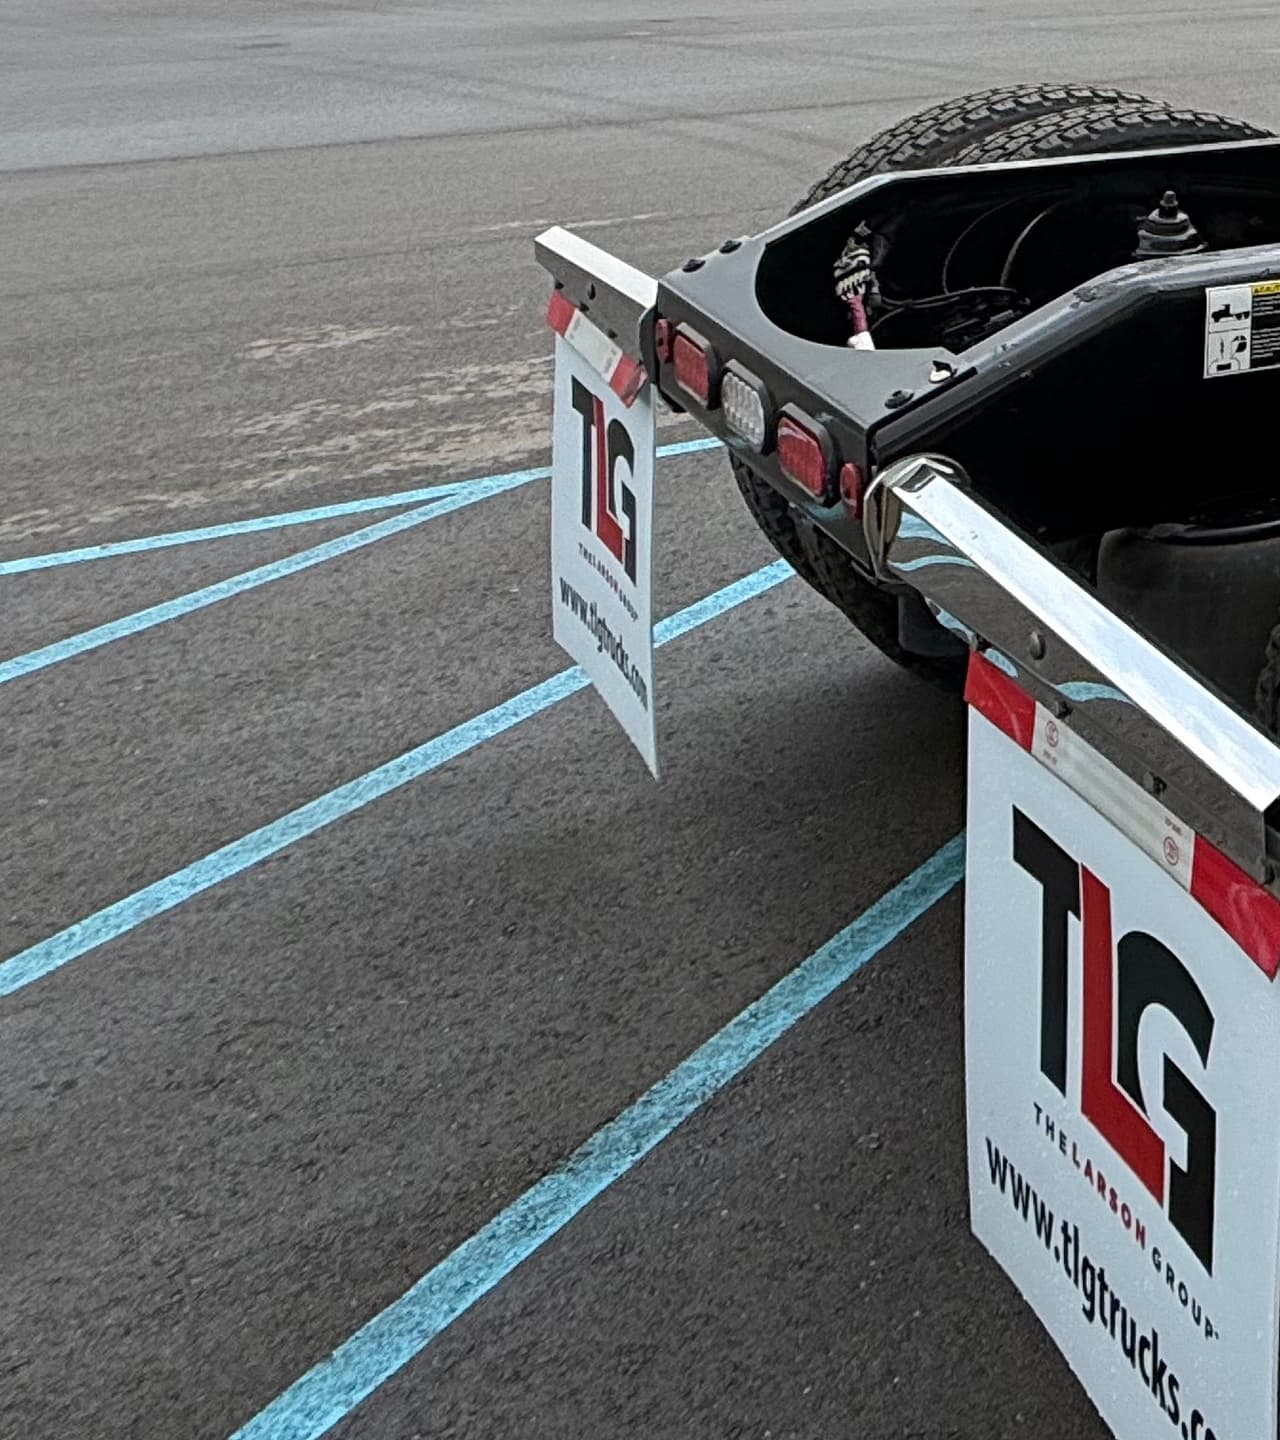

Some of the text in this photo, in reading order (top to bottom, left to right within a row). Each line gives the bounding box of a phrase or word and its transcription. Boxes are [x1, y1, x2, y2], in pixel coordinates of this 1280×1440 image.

[571, 375, 637, 586] TLG
[559, 576, 649, 712] www.tlgtrucks.com
[1012, 804, 1216, 1278] TLG
[985, 1137, 1218, 1440] www.tlgtrucks.c
[1033, 1101, 1214, 1340] THE LARSON GROUP
